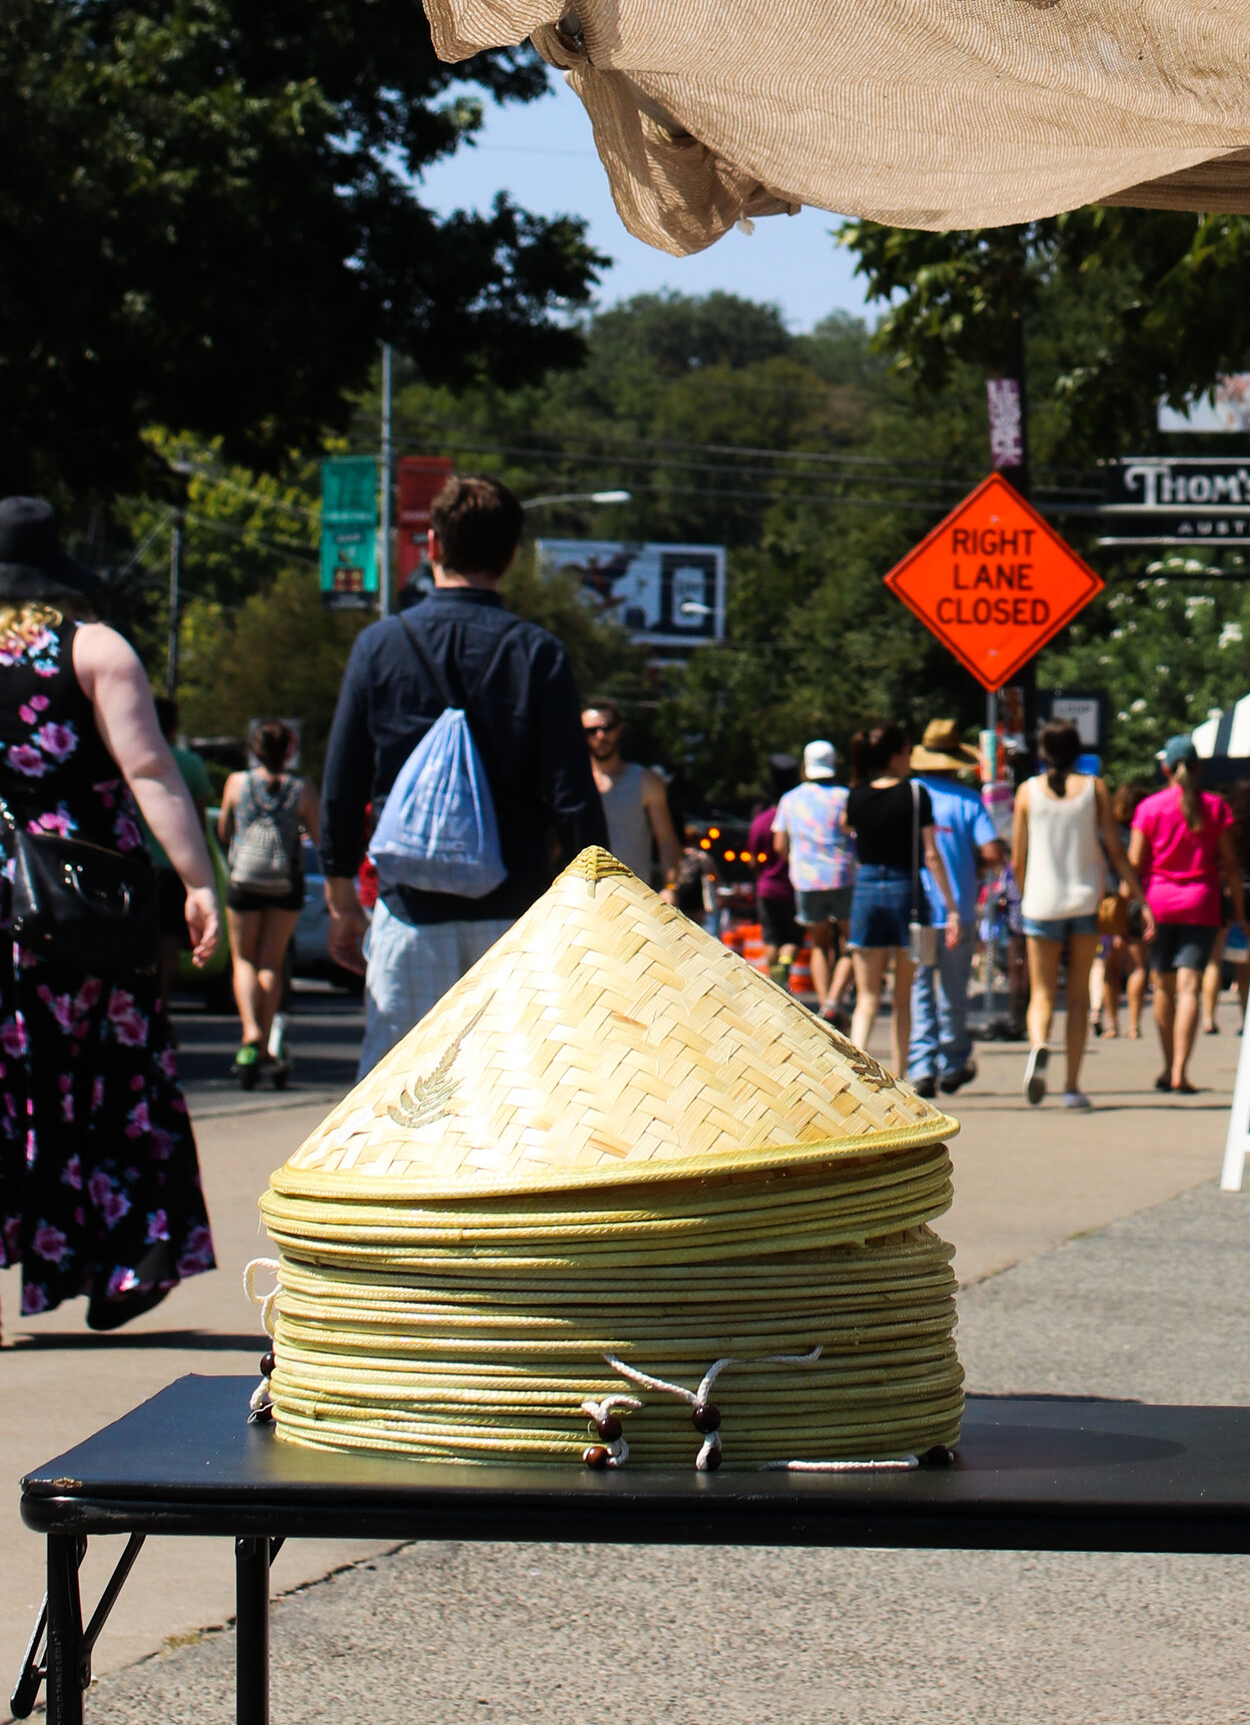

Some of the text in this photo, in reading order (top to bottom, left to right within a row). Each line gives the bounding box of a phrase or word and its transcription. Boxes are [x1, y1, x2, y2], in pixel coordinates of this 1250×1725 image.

[952, 528, 1037, 556] RIGHT
[953, 563, 1034, 590] LANE
[936, 597, 1051, 625] CLOSED
